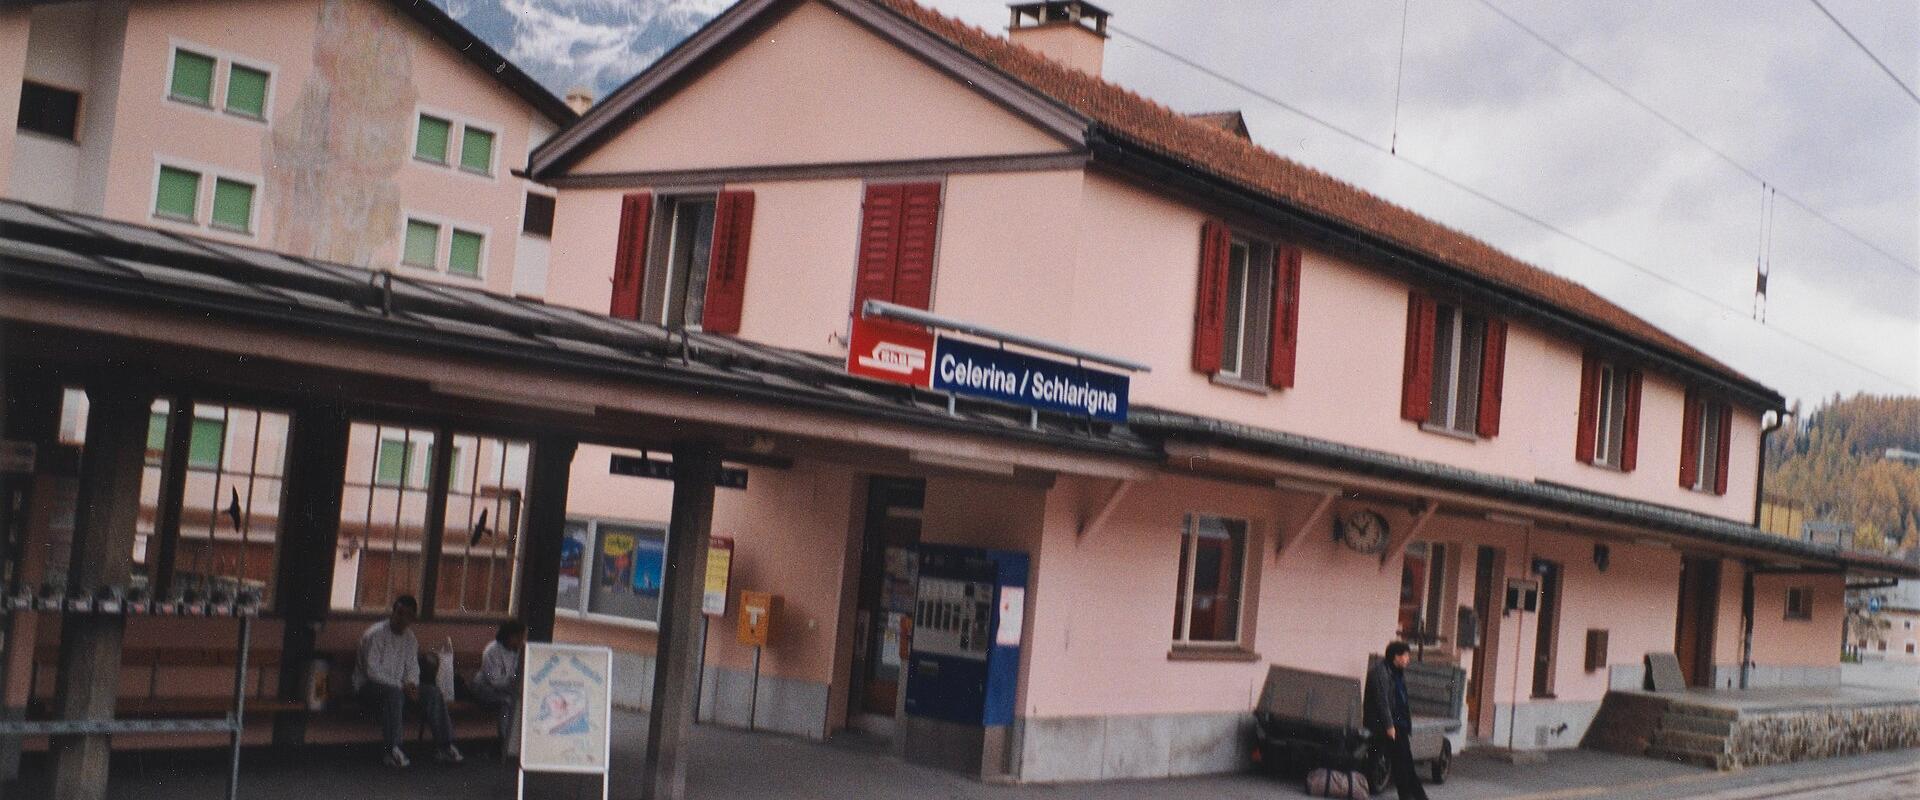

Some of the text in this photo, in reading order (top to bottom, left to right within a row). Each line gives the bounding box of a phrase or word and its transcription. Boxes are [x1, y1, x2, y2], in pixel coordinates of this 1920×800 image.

[941, 353, 1117, 415] Celerina / Schlarigna
